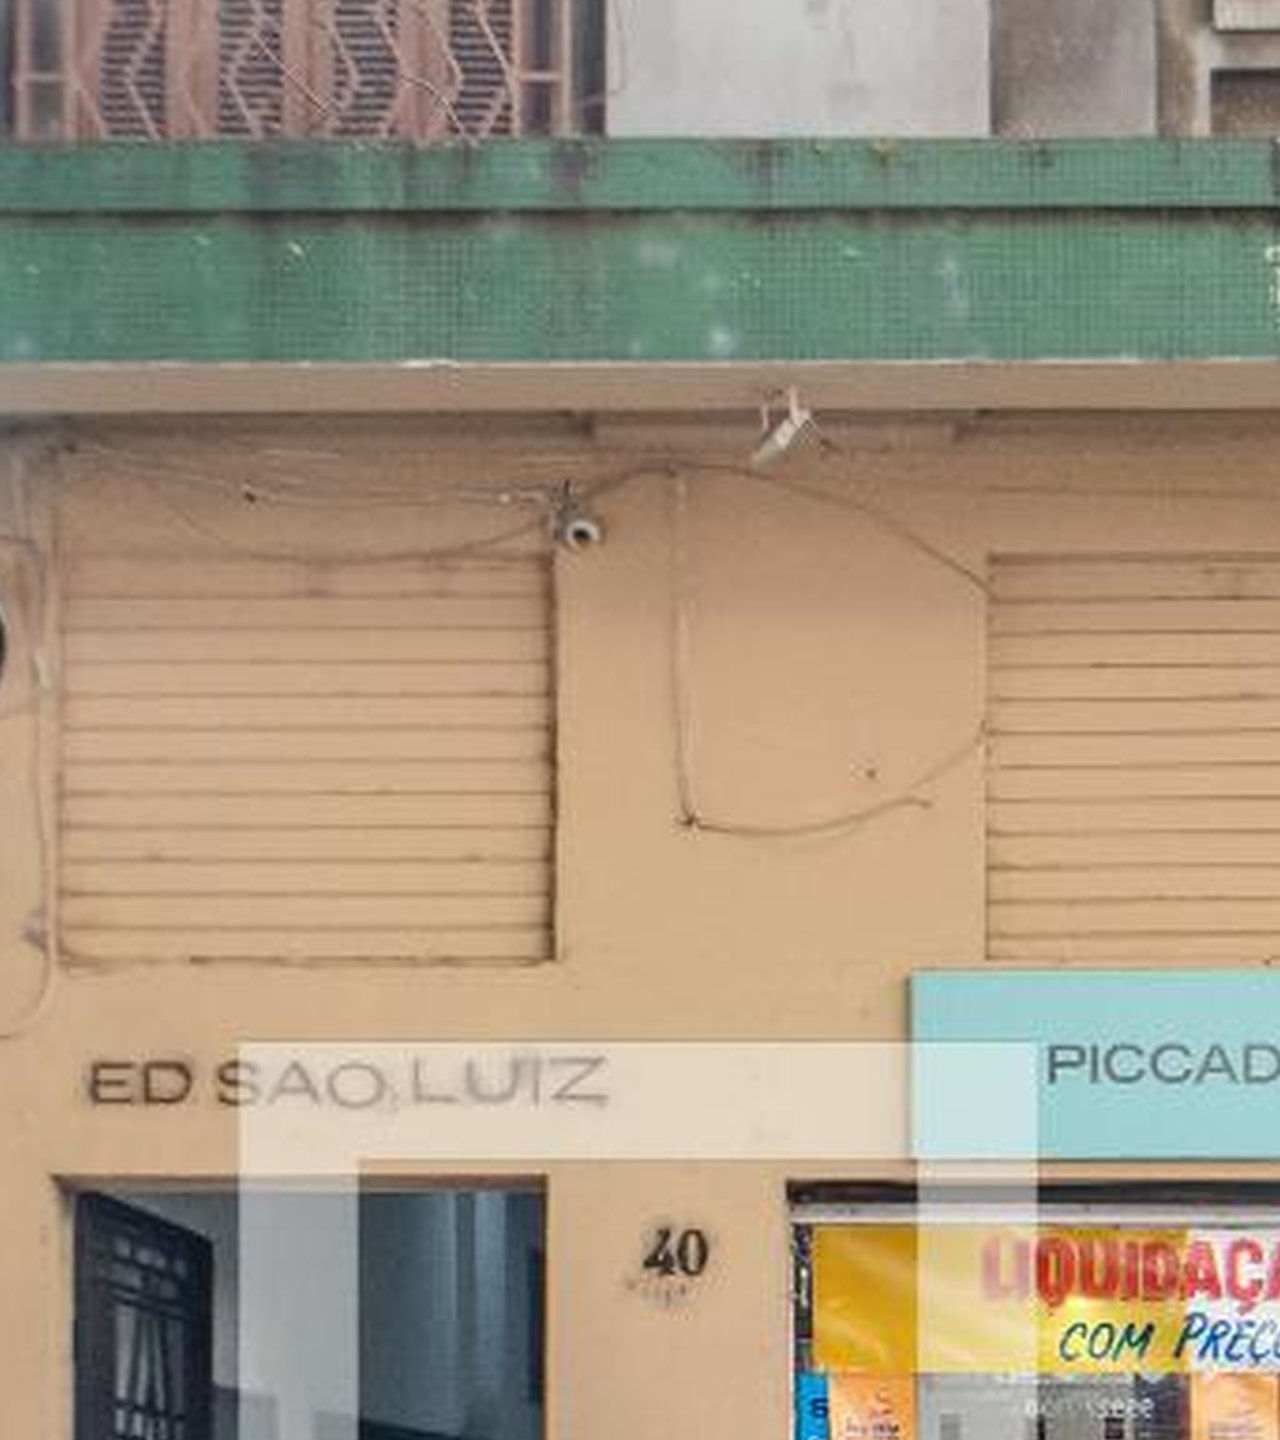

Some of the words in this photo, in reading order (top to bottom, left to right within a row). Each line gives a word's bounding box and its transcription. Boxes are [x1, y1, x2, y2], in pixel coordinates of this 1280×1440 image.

[90, 1061, 193, 1105] ED
[412, 1056, 609, 1105] LUIZ
[644, 1227, 709, 1277] 40
[1057, 1318, 1153, 1362] COM
